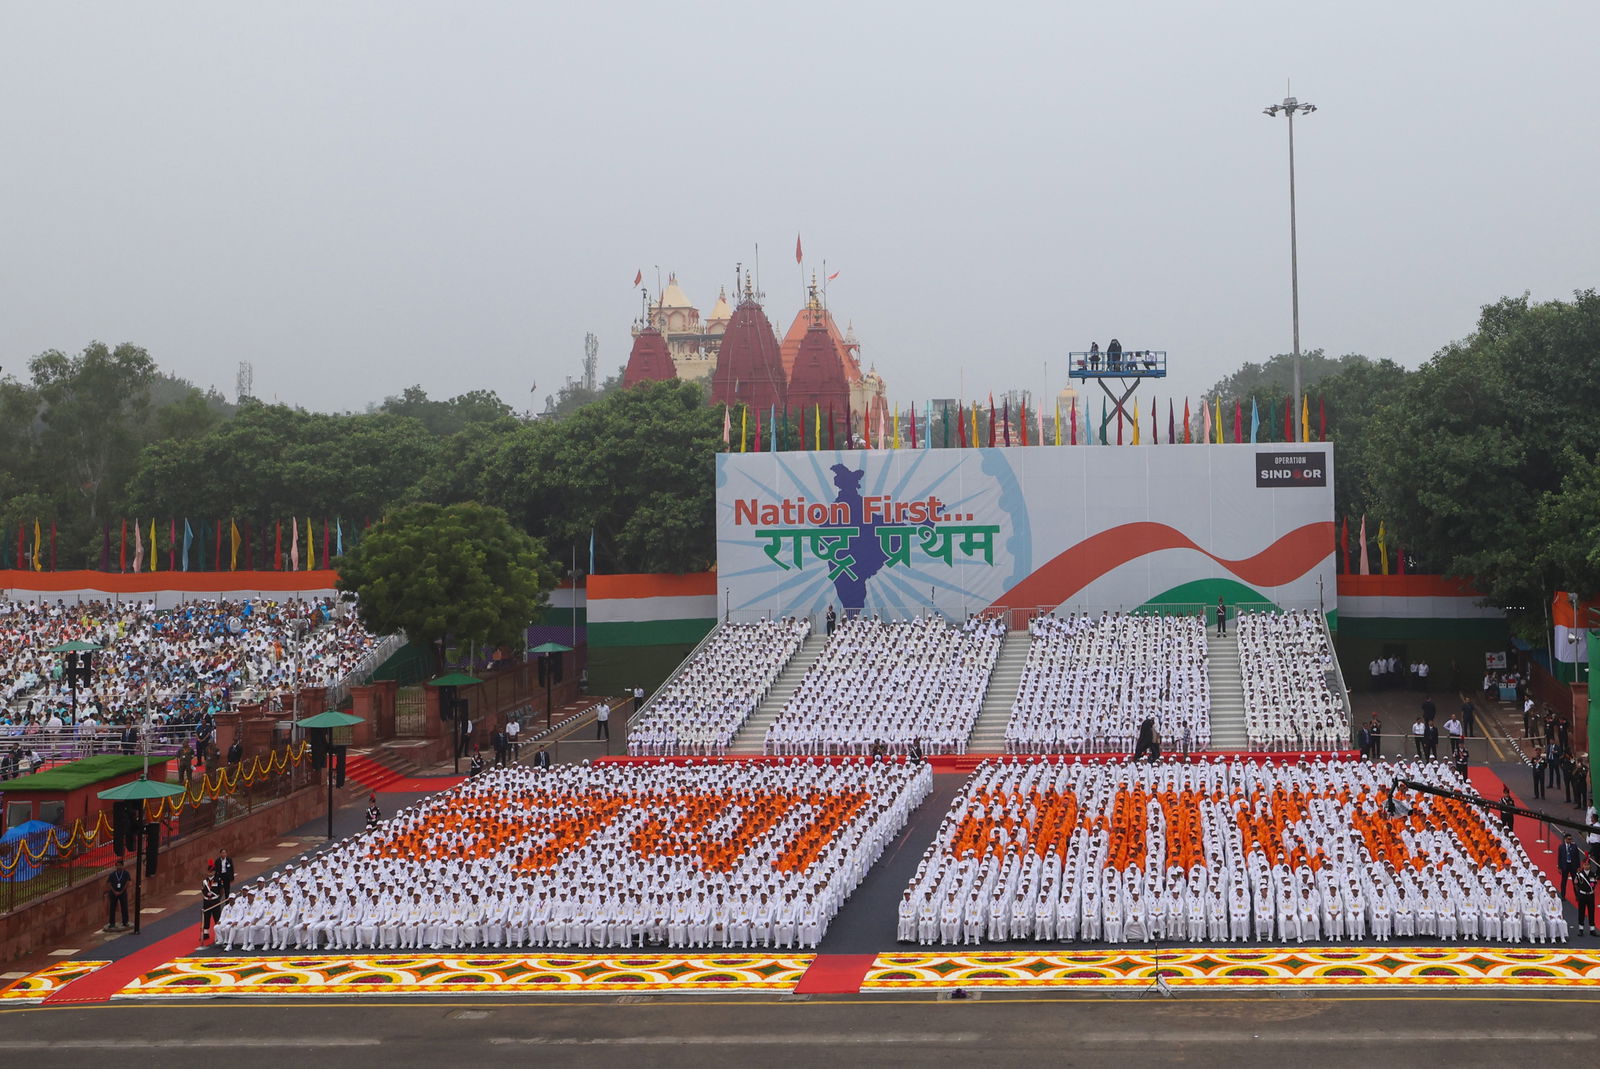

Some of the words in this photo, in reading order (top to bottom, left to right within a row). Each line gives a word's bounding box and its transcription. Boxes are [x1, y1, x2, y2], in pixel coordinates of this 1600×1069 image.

[1274, 456, 1307, 465] OPERATION
[734, 496, 850, 526] Nation
[863, 495, 974, 524] First...
[755, 527, 859, 581] राष्ट्र
[875, 525, 1000, 569] प्रथम
